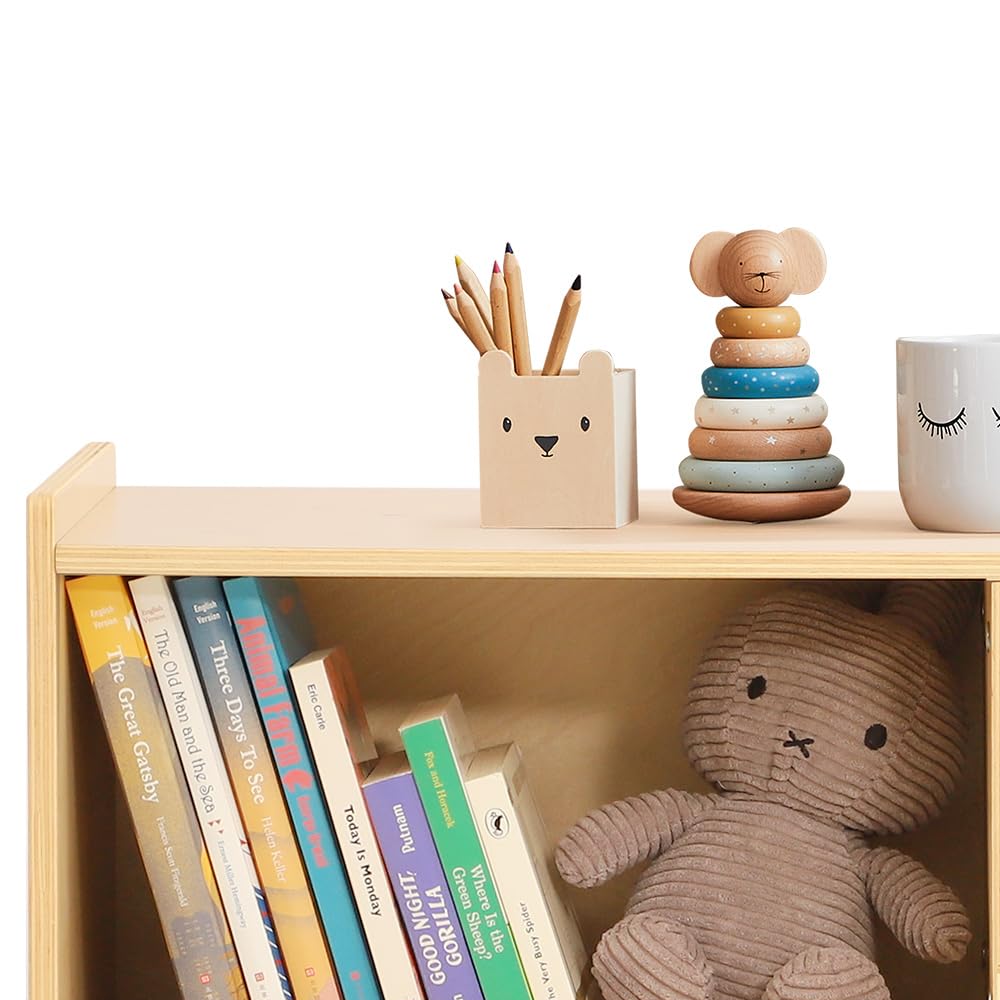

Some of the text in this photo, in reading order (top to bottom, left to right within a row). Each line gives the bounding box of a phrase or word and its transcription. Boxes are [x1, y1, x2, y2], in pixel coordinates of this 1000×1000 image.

[193, 600, 217, 613] English
[196, 612, 220, 624] Version
[107, 645, 159, 802] The Great Gatsby
[154, 628, 215, 813] The Old Man and the Sea
[210, 639, 264, 803] Three Days To See
[307, 683, 325, 729] Eric Carle
[430, 770, 443, 788] and
[261, 816, 286, 880] Helen Keller
[393, 804, 415, 853] Putnam
[344, 804, 381, 915] Today Is Monday
[425, 886, 462, 965] GORILLA
[452, 867, 492, 959] Green Sheep?
[470, 864, 504, 952] Where Is the
[519, 902, 534, 933] Spider
[419, 934, 445, 984] GOOD
[531, 936, 542, 959] Busy
[539, 962, 549, 983] Very
